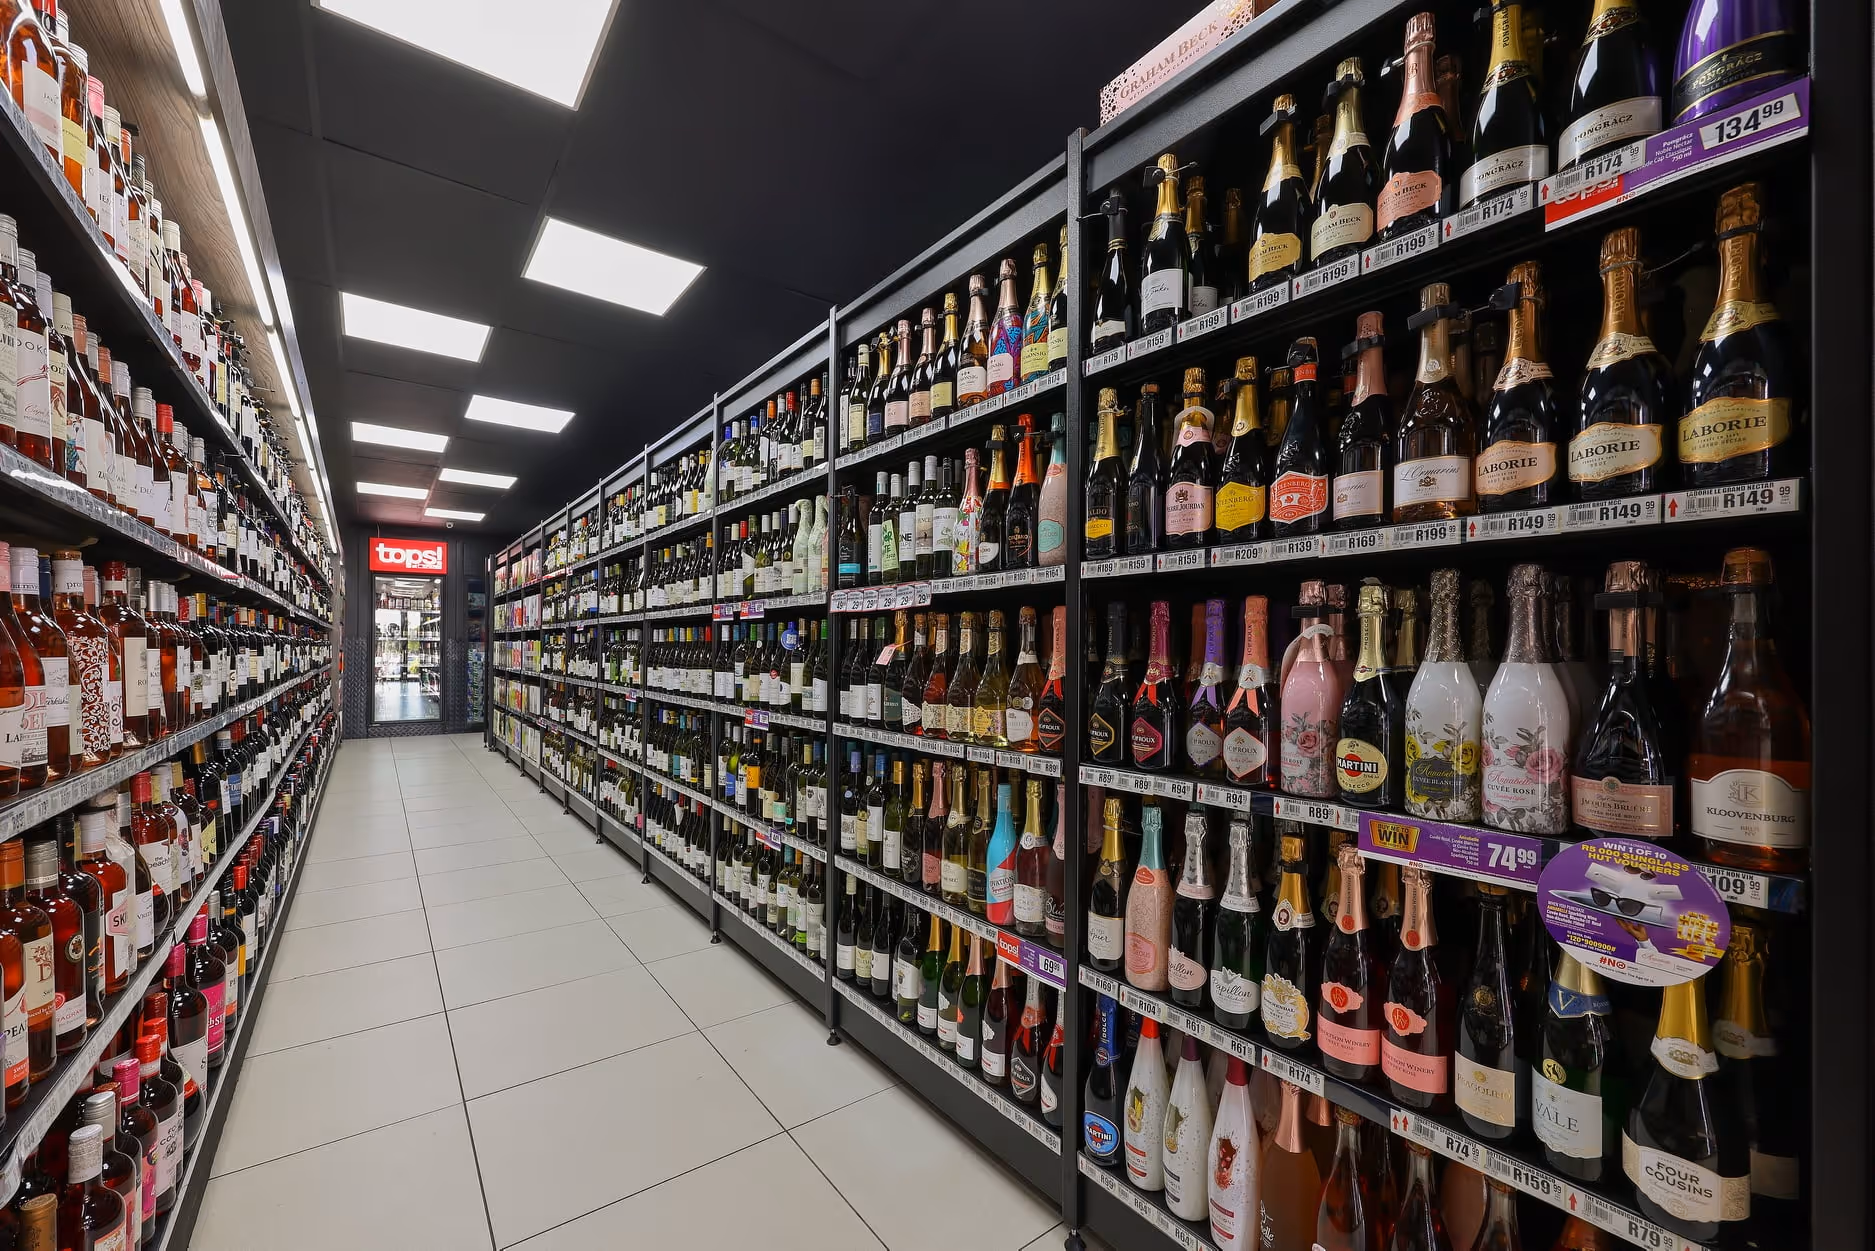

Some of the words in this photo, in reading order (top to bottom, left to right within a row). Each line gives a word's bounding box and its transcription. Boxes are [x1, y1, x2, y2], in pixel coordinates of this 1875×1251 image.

[1120, 51, 1175, 99] GRAHAM
[1178, 20, 1218, 57] BECK
[1715, 109, 1761, 143] 134
[1762, 100, 1784, 119] 99
[1585, 154, 1623, 180] R174
[1629, 146, 1640, 156] 99
[1482, 199, 1514, 220] R174
[1519, 190, 1528, 200] 99
[1395, 236, 1427, 257] R199
[1322, 264, 1348, 284] R199
[1257, 291, 1280, 308] R199
[1200, 316, 1220, 331] R199
[1147, 335, 1165, 350] R159
[1682, 416, 1767, 442] LABORIE
[1571, 440, 1641, 463] LABORIE
[1478, 457, 1538, 477] LABORIE
[1723, 489, 1774, 509] R149
[1779, 486, 1791, 496] 99
[1600, 503, 1642, 521] R149
[1645, 500, 1655, 510] 99
[1508, 515, 1545, 531] R149
[1547, 513, 1556, 522] 99
[1348, 534, 1376, 549] R169
[1416, 528, 1447, 542] R199
[1448, 525, 1457, 533] 99
[376, 542, 442, 569] tops!
[1235, 547, 1259, 561] R209
[1288, 540, 1312, 554] R139
[1128, 559, 1146, 570] R159
[1178, 554, 1198, 566] R159
[1337, 757, 1377, 773] MARTINI
[1098, 773, 1112, 784] R89
[1134, 779, 1149, 790] R89
[1171, 783, 1187, 795] R94
[1226, 793, 1243, 806] R94
[1308, 806, 1329, 820] R89
[1706, 806, 1796, 823] KLOOVENBURG
[1377, 823, 1390, 831] BUY
[1378, 828, 1409, 846] WIN
[1487, 842, 1517, 872] 74
[1517, 850, 1537, 866] 99
[1581, 844, 1596, 853] R5
[1598, 847, 1620, 857] 000
[1622, 852, 1690, 872] SUNGLASS
[1603, 842, 1626, 852] WIN
[1636, 847, 1652, 856] OF
[1654, 851, 1667, 860] 10
[1588, 852, 1611, 863] HUT
[1613, 857, 1681, 877] VOUCHERS
[1708, 875, 1746, 895] 109
[1750, 880, 1761, 891] 99
[999, 937, 1019, 957] tops!
[1043, 958, 1054, 973] 69
[1095, 978, 1112, 992] R169
[1138, 1000, 1156, 1015] R104
[1186, 1019, 1200, 1033] R61
[1231, 1039, 1247, 1056] R61
[1288, 1066, 1311, 1085] R174
[1535, 1096, 1580, 1133] VALE
[1086, 1125, 1113, 1142] MARTINI
[1446, 1136, 1470, 1158] R74
[1471, 1147, 1480, 1157] 99
[1100, 1174, 1115, 1190] R99
[1513, 1167, 1551, 1195] R159
[1553, 1184, 1562, 1194] 99
[1645, 1165, 1713, 1198] COUSINS
[1656, 1161, 1700, 1185] FOUR
[1134, 1198, 1148, 1215] R64
[1175, 1228, 1190, 1246] R64
[1628, 1219, 1661, 1249] R79
[1663, 1235, 1673, 1248] 99
